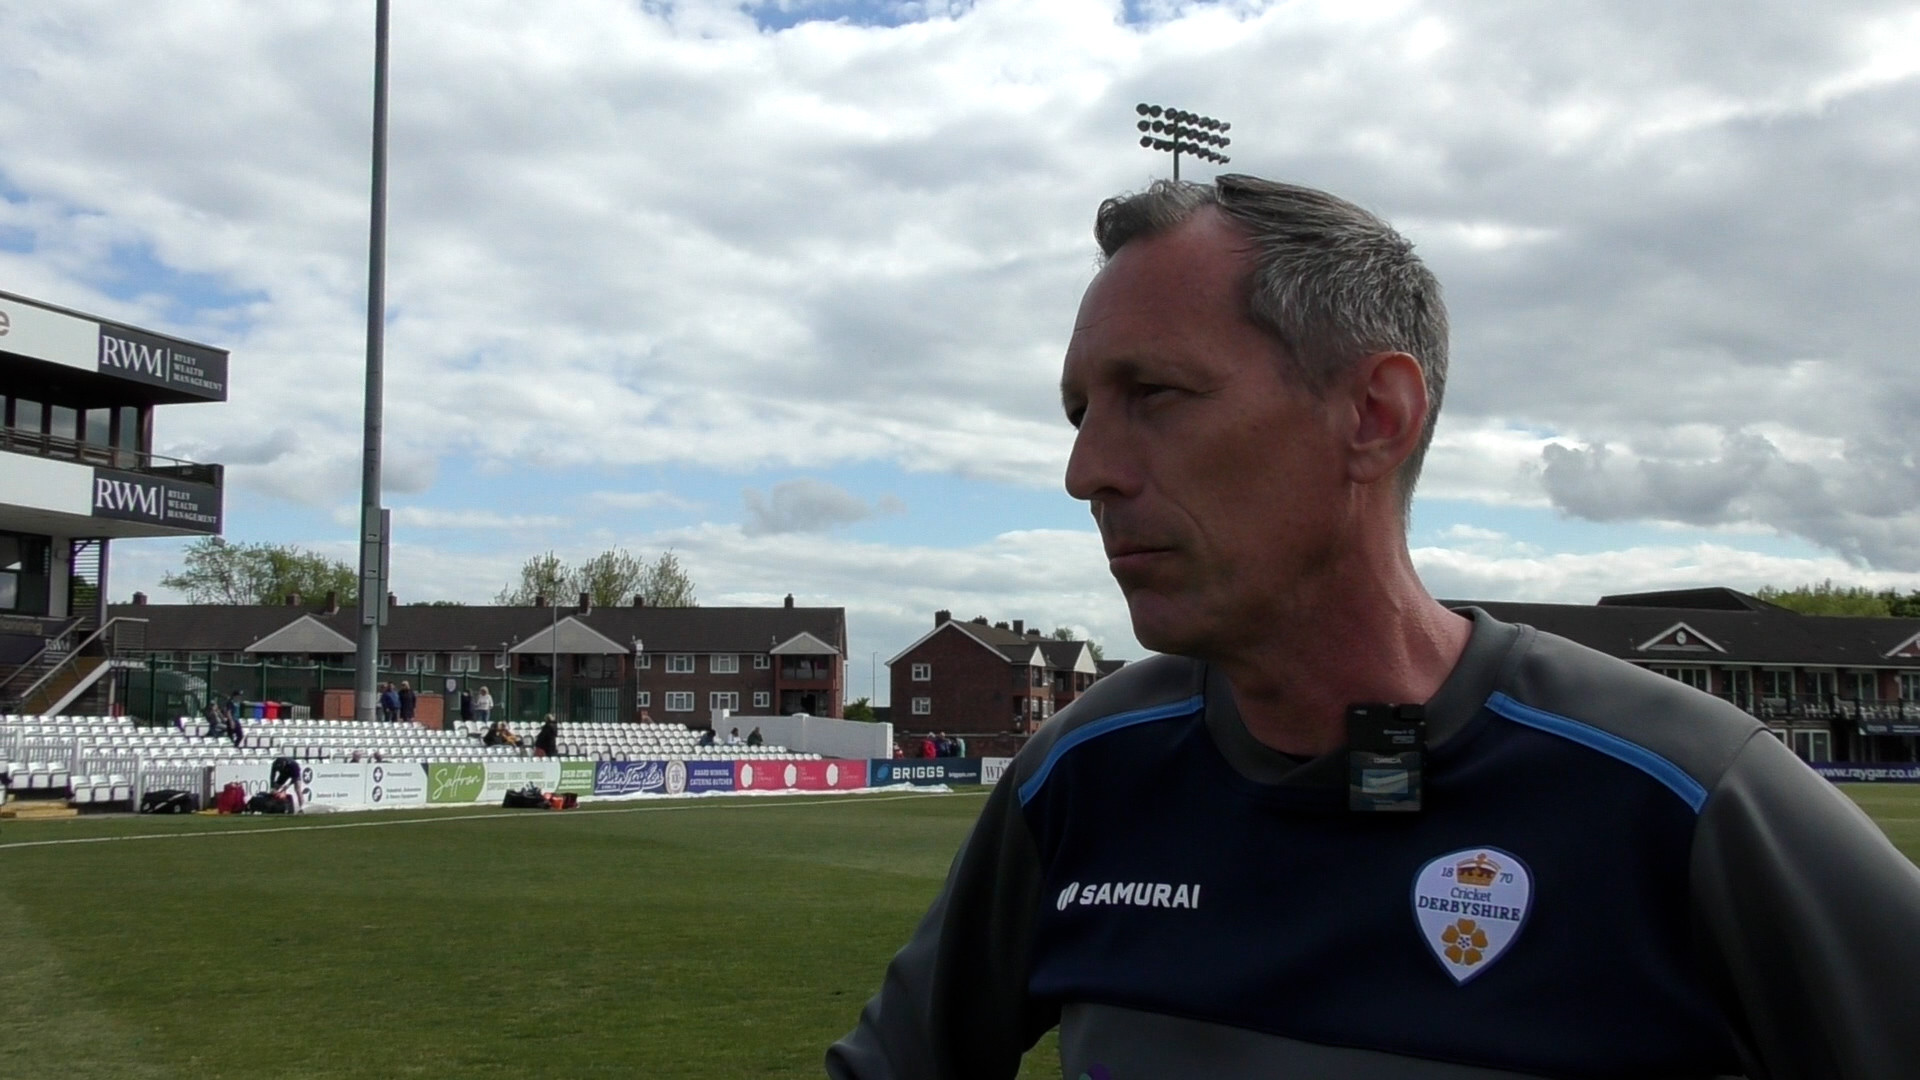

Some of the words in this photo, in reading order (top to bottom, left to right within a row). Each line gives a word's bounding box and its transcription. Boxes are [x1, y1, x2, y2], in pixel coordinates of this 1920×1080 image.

[102, 335, 162, 377] RWM
[173, 363, 204, 377] WEALTH
[173, 373, 222, 391] MANAGEMENT
[95, 478, 157, 515] RWM
[167, 500, 198, 511] WEALTH
[167, 509, 217, 524] MANAGEMENT
[892, 766, 944, 780] BRIGGS
[432, 765, 480, 800] Saffron
[1441, 867, 1454, 878] 18
[1500, 872, 1513, 884] 70
[1079, 882, 1200, 909] SAMURAI
[1451, 887, 1492, 903] Cricket
[1418, 895, 1520, 922] DERBYSHIRE
